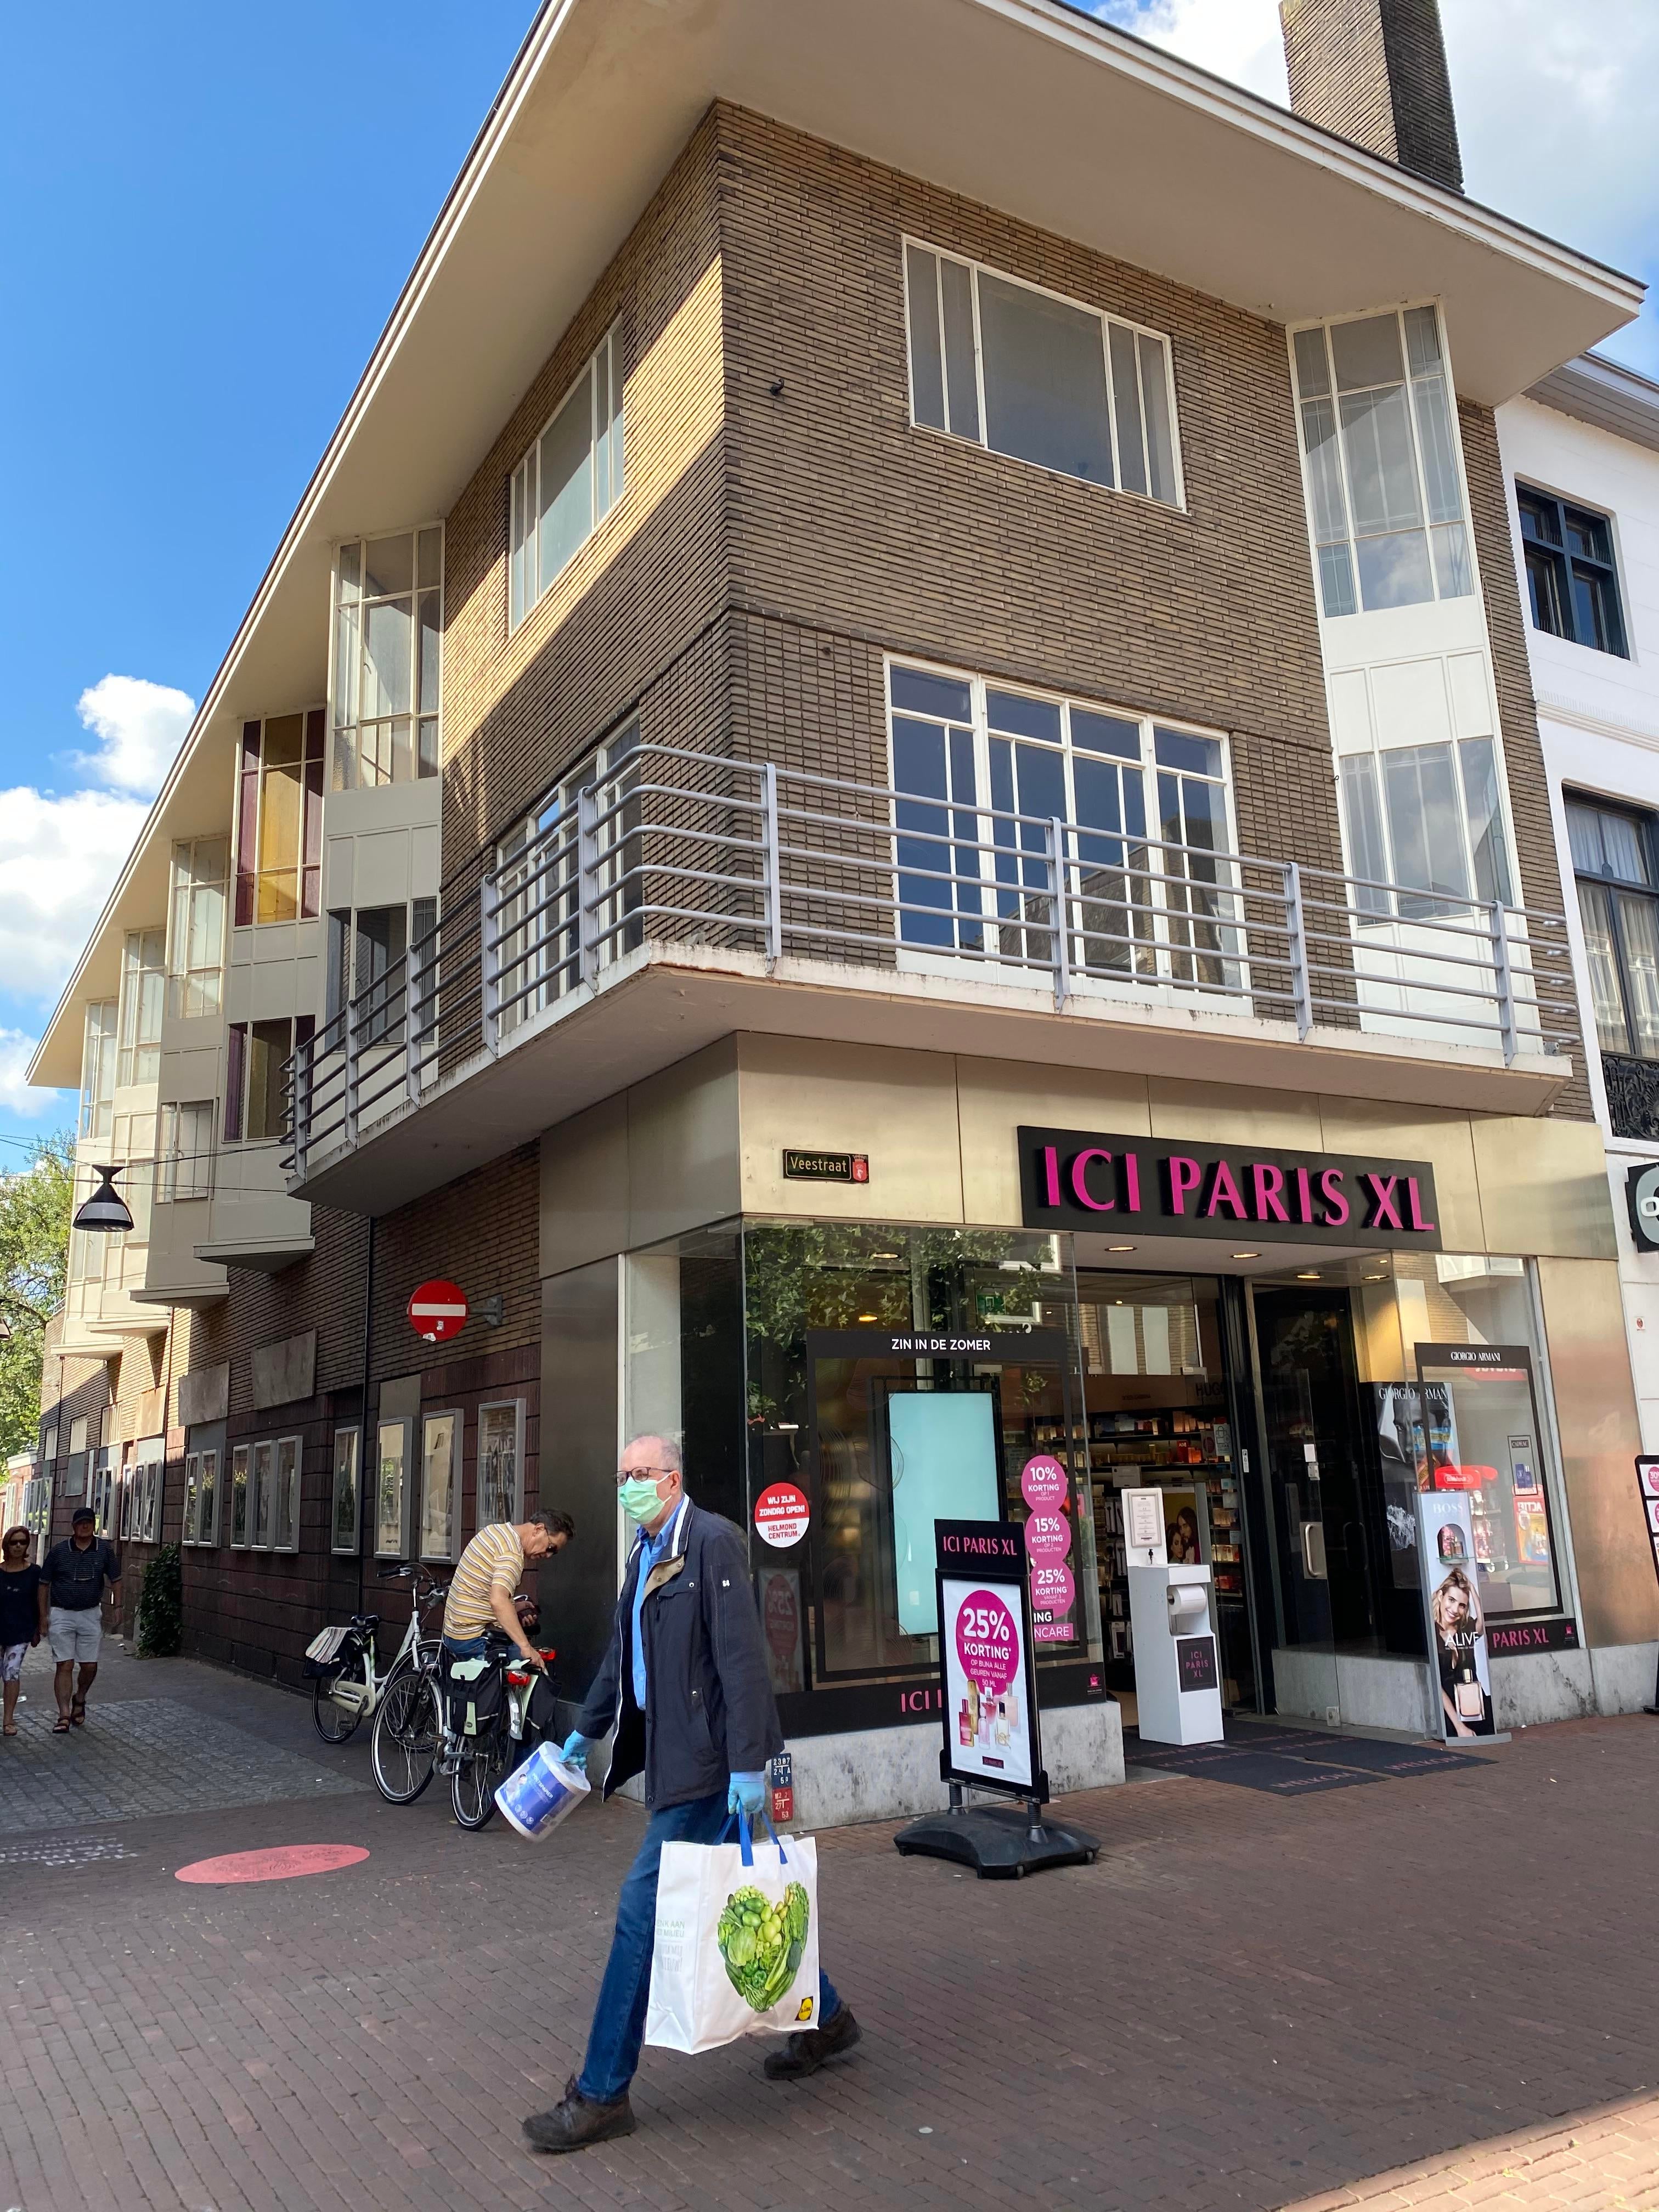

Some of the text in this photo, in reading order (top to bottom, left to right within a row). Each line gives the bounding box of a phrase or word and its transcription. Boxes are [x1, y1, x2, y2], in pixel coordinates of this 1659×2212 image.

[790, 1156, 848, 1173] Veestraat
[1043, 1146, 1435, 1231] ICI PARIS XL
[891, 1339, 991, 1351] ZIN IN DE ZOMER
[1451, 1351, 1501, 1362] GIORGIO ARMANI
[1030, 1466, 1057, 1481] 10%
[768, 1495, 796, 1504] WIJ ZIJN
[759, 1505, 805, 1516] ZONDAG OPEN!
[1432, 1502, 1463, 1514] BOSS
[768, 1523, 797, 1532] HELMOND
[1034, 1517, 1060, 1532] 15%
[943, 1536, 1017, 1555] ICI PARIS XL
[1037, 1568, 1065, 1584] 25%
[963, 1607, 1009, 1641] 25%
[1444, 1631, 1479, 1647] ALIVE
[1493, 1627, 1549, 1649] PARIS XL
[1190, 1651, 1202, 1659] ICI
[994, 1662, 1006, 1670] ALLE
[1185, 1660, 1209, 1669] PARIS
[970, 1668, 1007, 1679] GEUREN VANAF
[1194, 1670, 1203, 1678] XL
[901, 1690, 930, 1712] ICI
